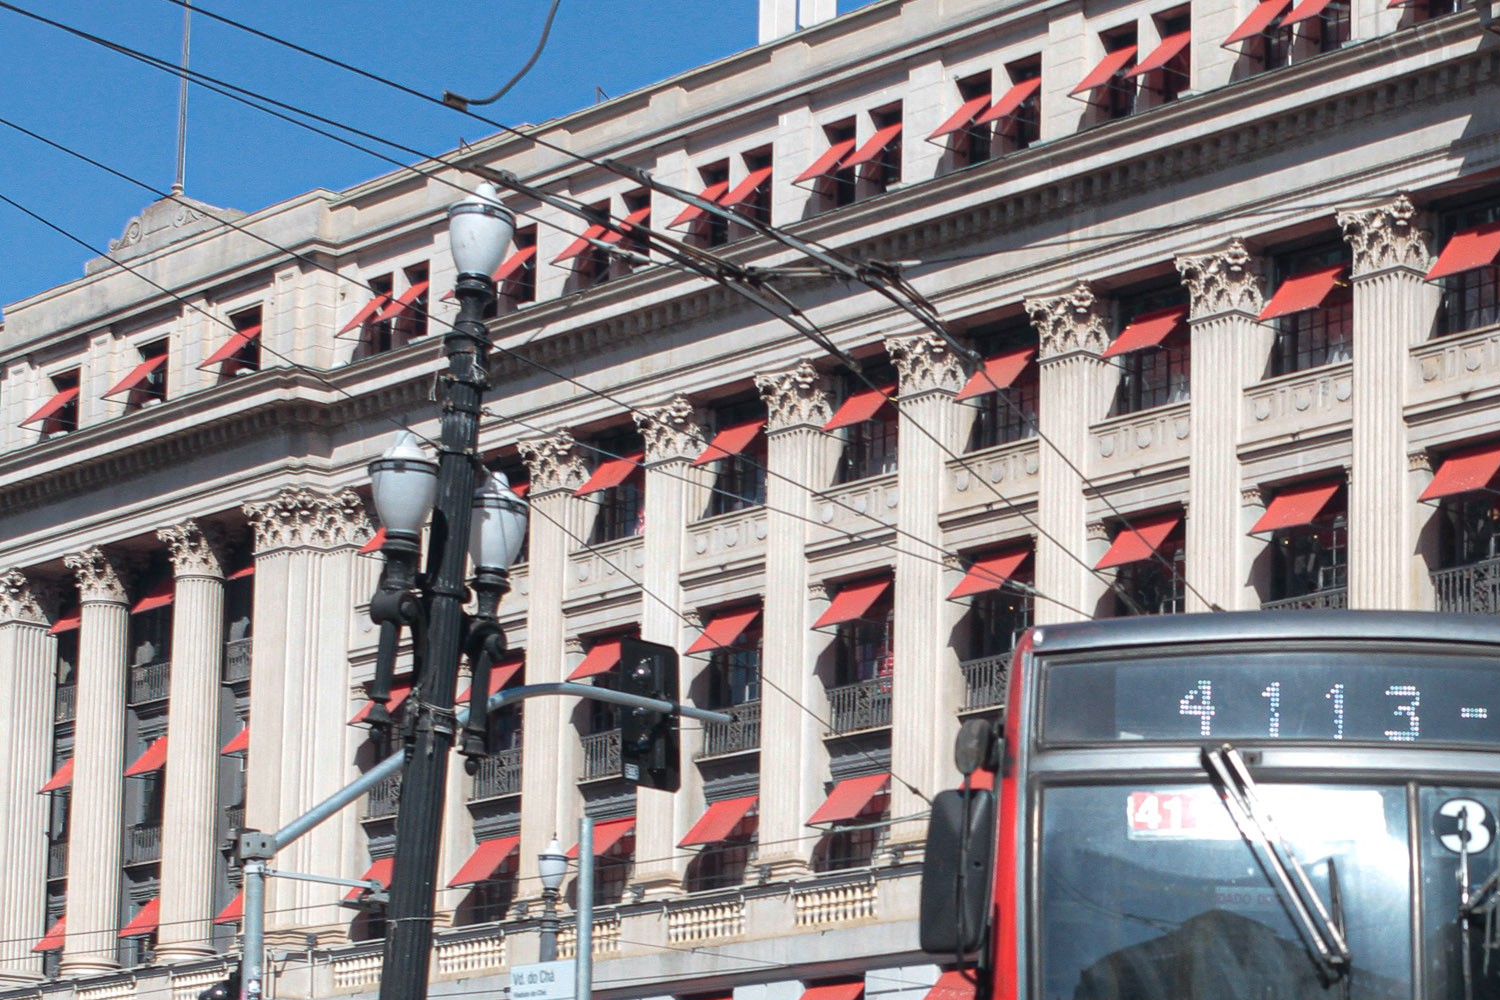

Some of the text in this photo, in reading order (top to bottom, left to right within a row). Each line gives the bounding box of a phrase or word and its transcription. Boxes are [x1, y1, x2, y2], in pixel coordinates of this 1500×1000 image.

[1440, 799, 1492, 853] 3
[512, 973, 526, 986] Vd.
[527, 972, 538, 984] do
